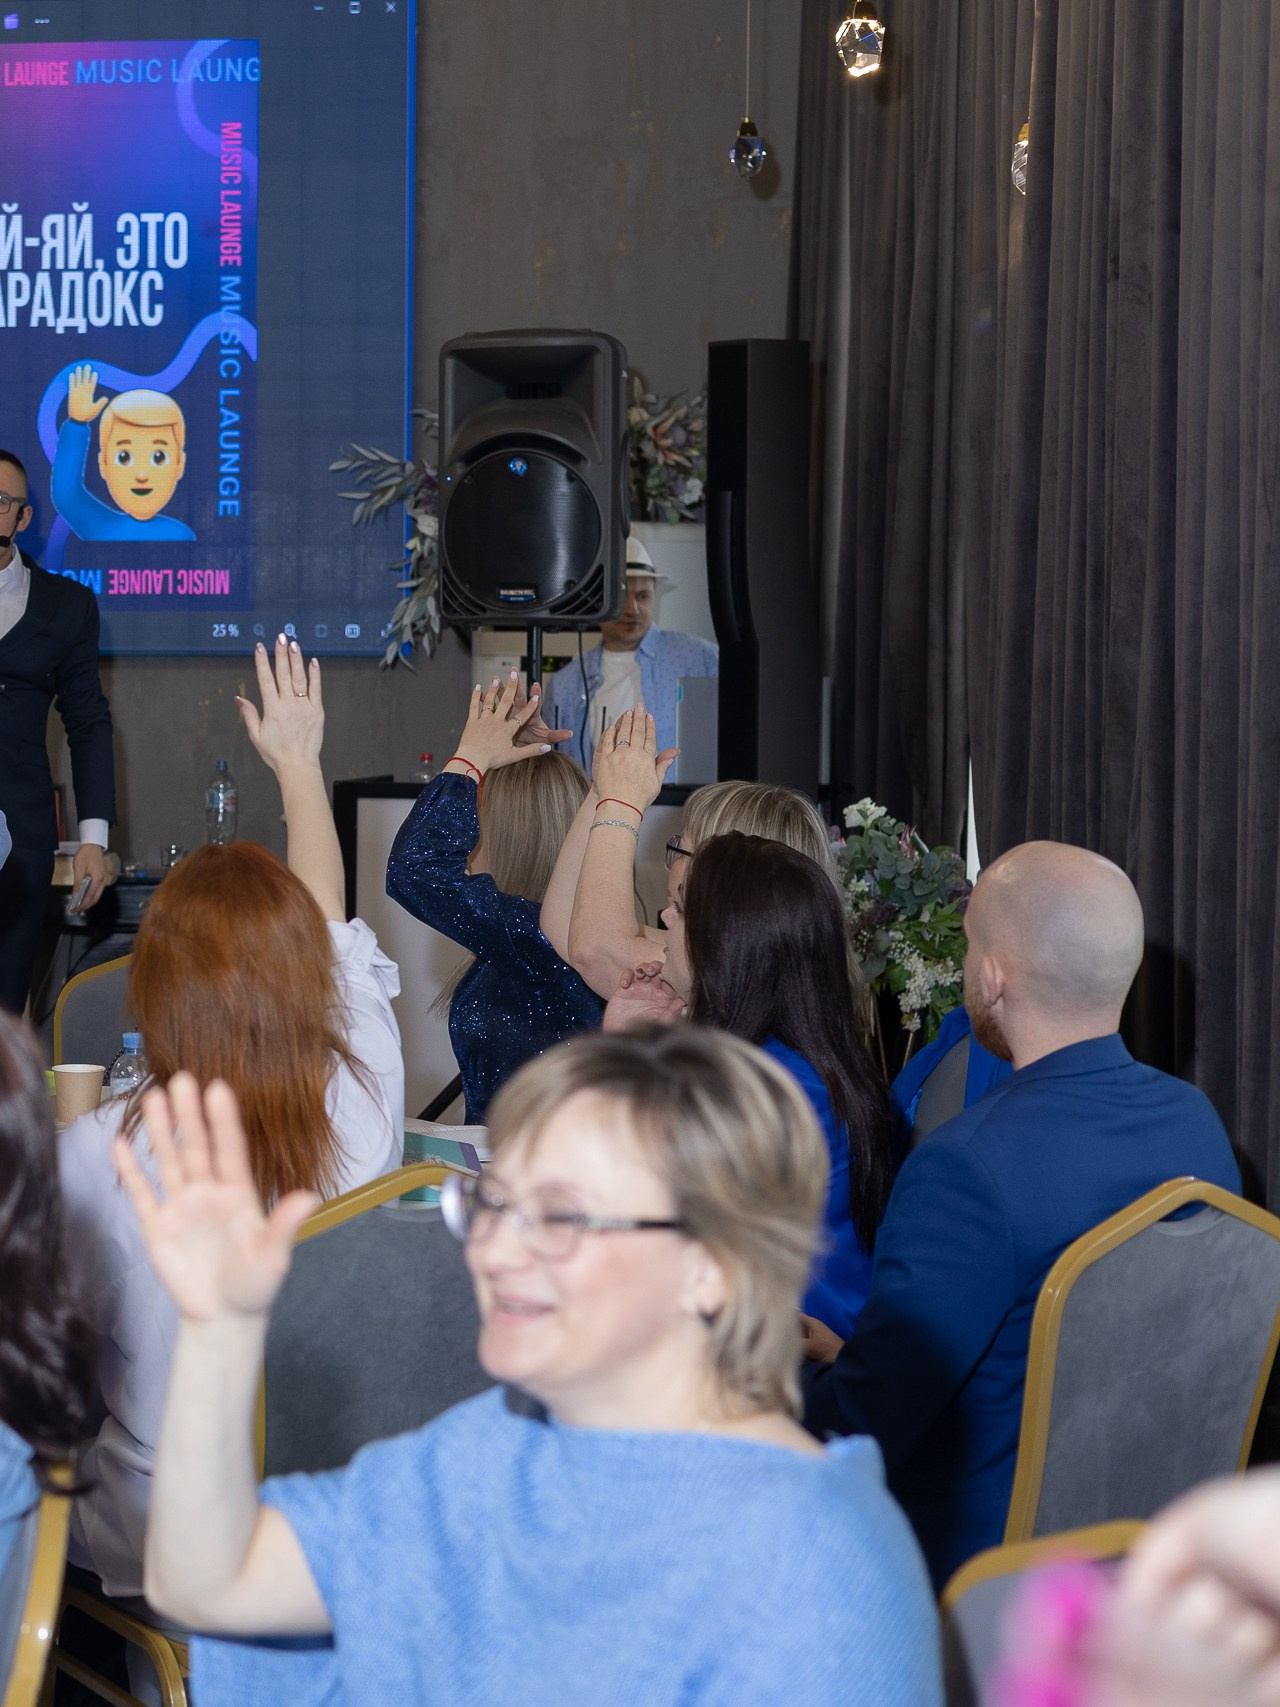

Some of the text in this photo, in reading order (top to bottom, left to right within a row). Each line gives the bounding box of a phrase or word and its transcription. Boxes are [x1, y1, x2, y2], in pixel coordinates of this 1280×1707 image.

[4, 61, 69, 86] LAUNGE
[75, 59, 162, 84] MUSIC
[116, 211, 189, 270] ЭТО
[218, 122, 242, 517] MUSIC LAUNGE MUSIC LAUNGE
[108, 569, 174, 595] LAUNGE
[177, 569, 230, 595] MUSIC
